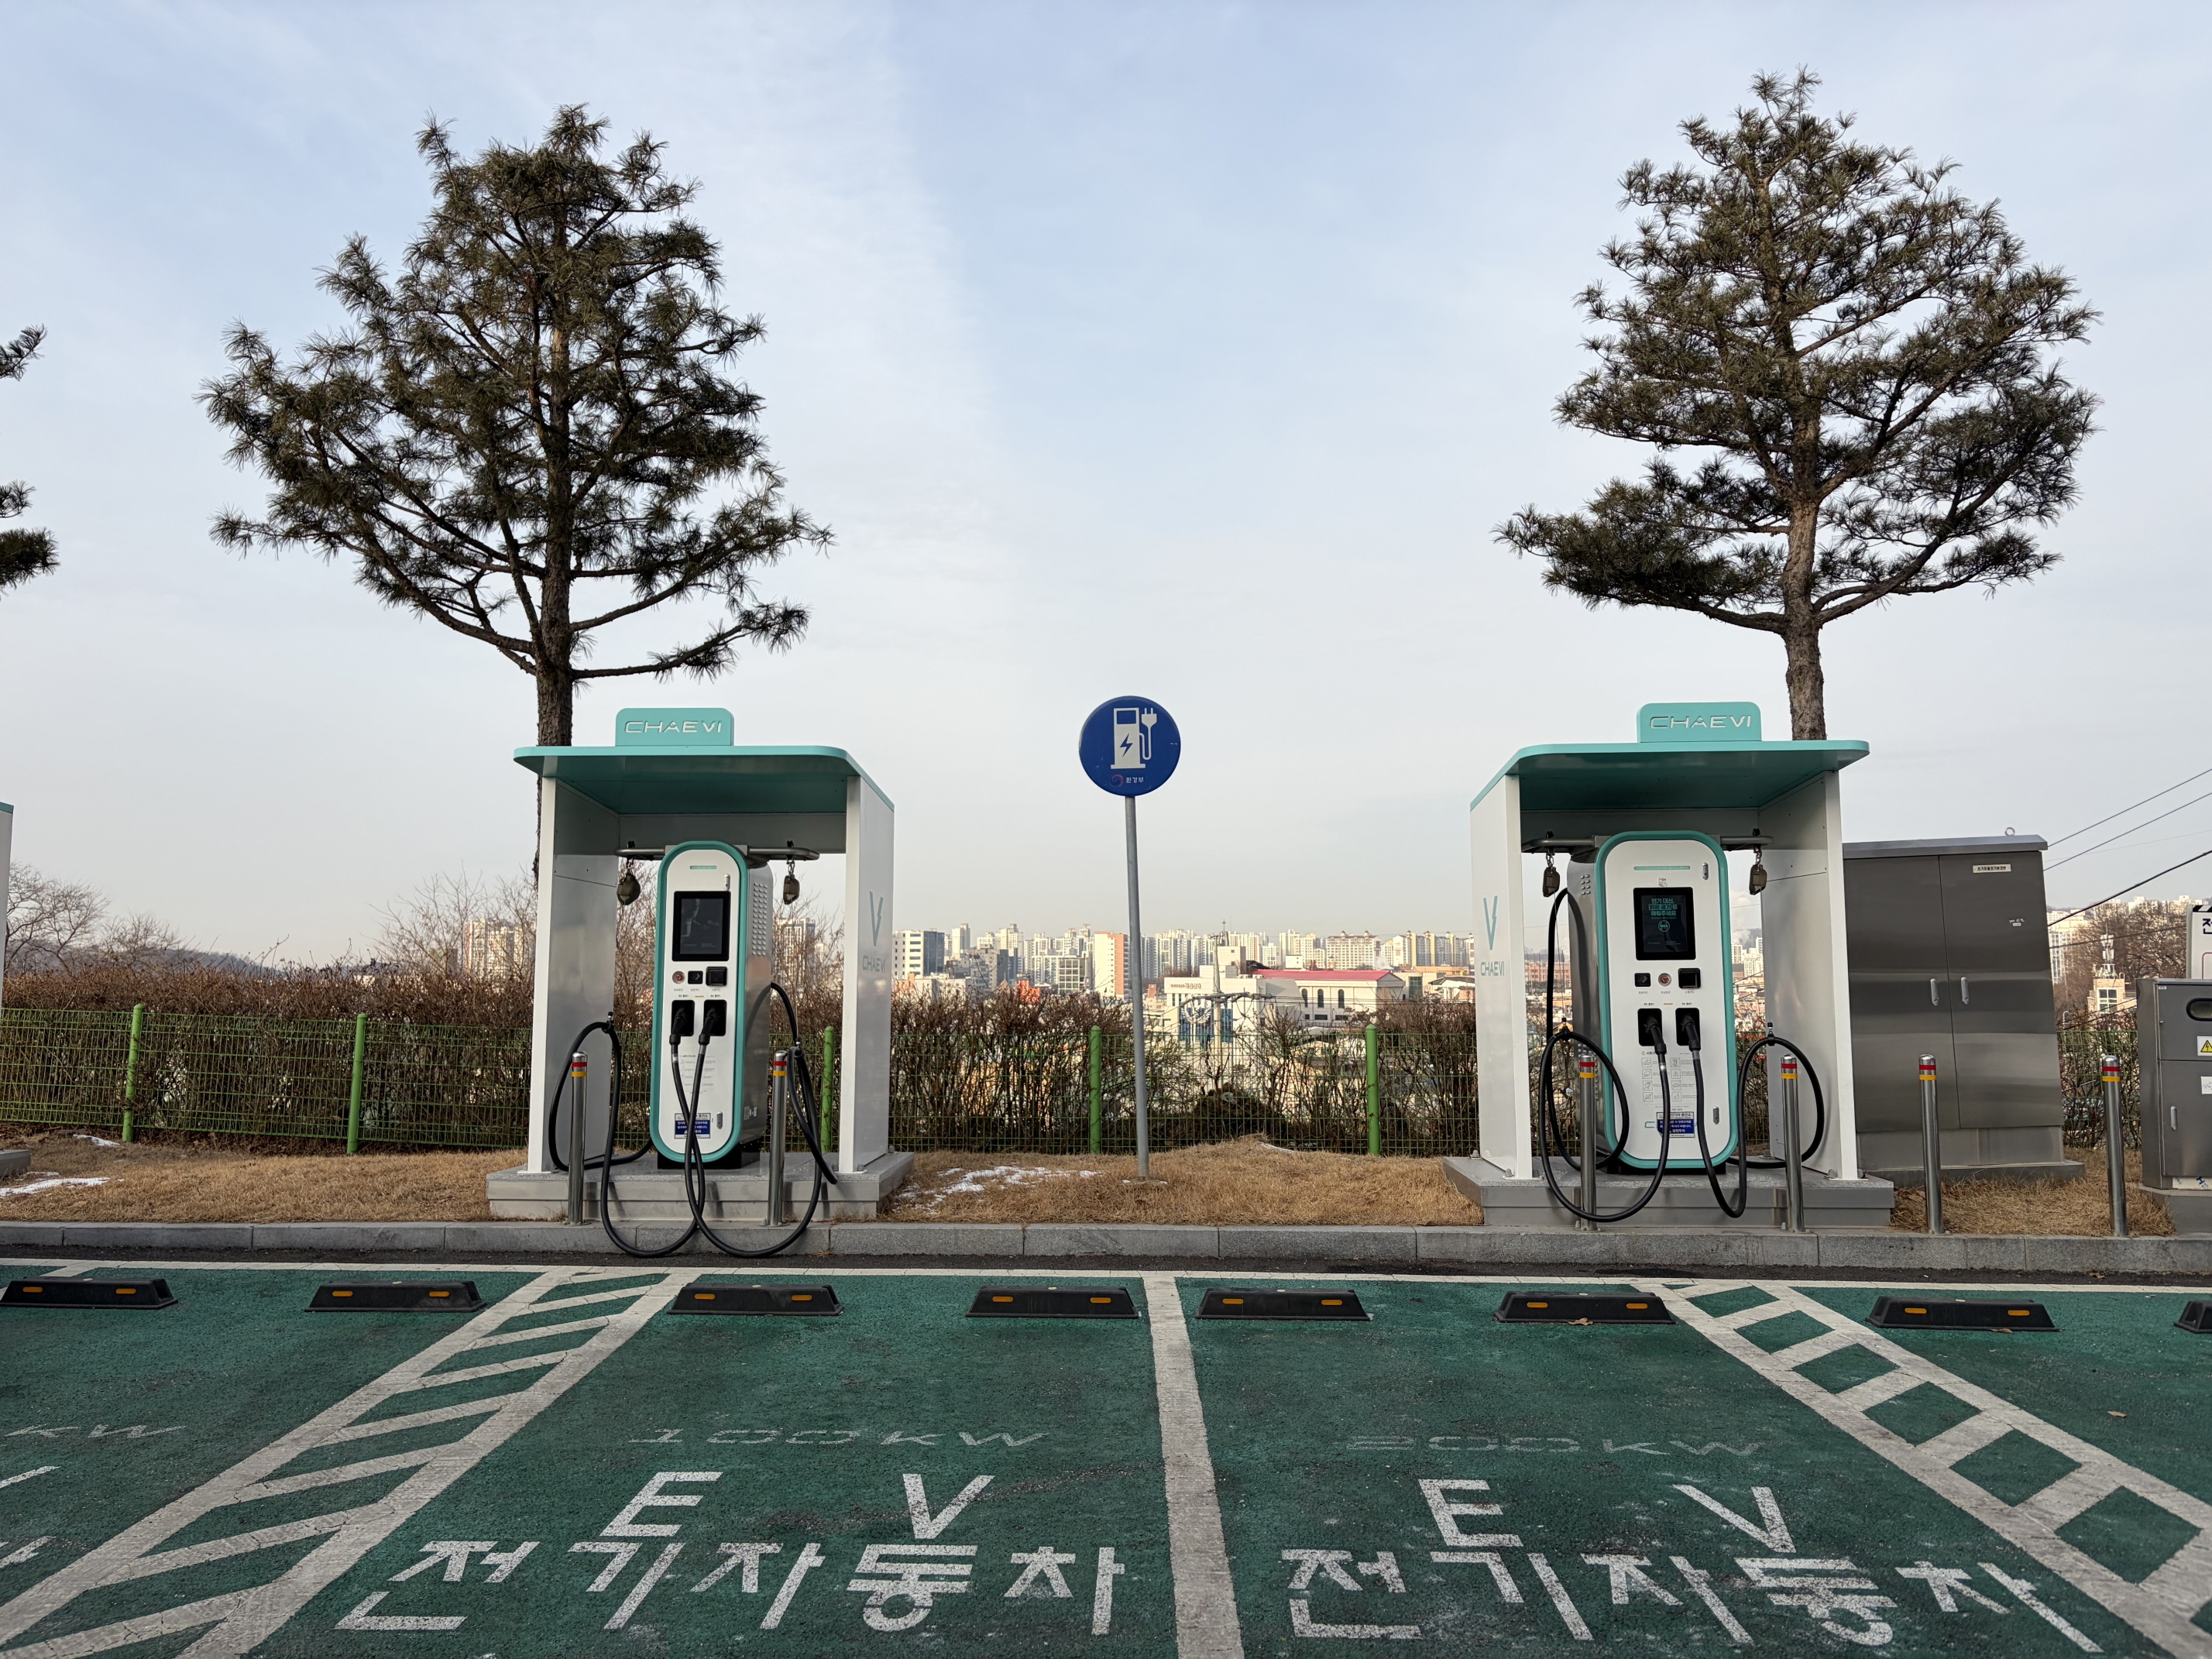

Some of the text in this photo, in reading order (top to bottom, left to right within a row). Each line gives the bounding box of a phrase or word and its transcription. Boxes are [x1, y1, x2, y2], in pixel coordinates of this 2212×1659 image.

[624, 720, 723, 733] CHAEVI
[1649, 715, 1752, 730] CHAEVI
[861, 955, 886, 974] CHAEVI
[1480, 960, 1505, 977] CHAEVI
[334, 1540, 1126, 1636] 전기자동차
[1281, 1548, 2105, 1653] 전기자동차
